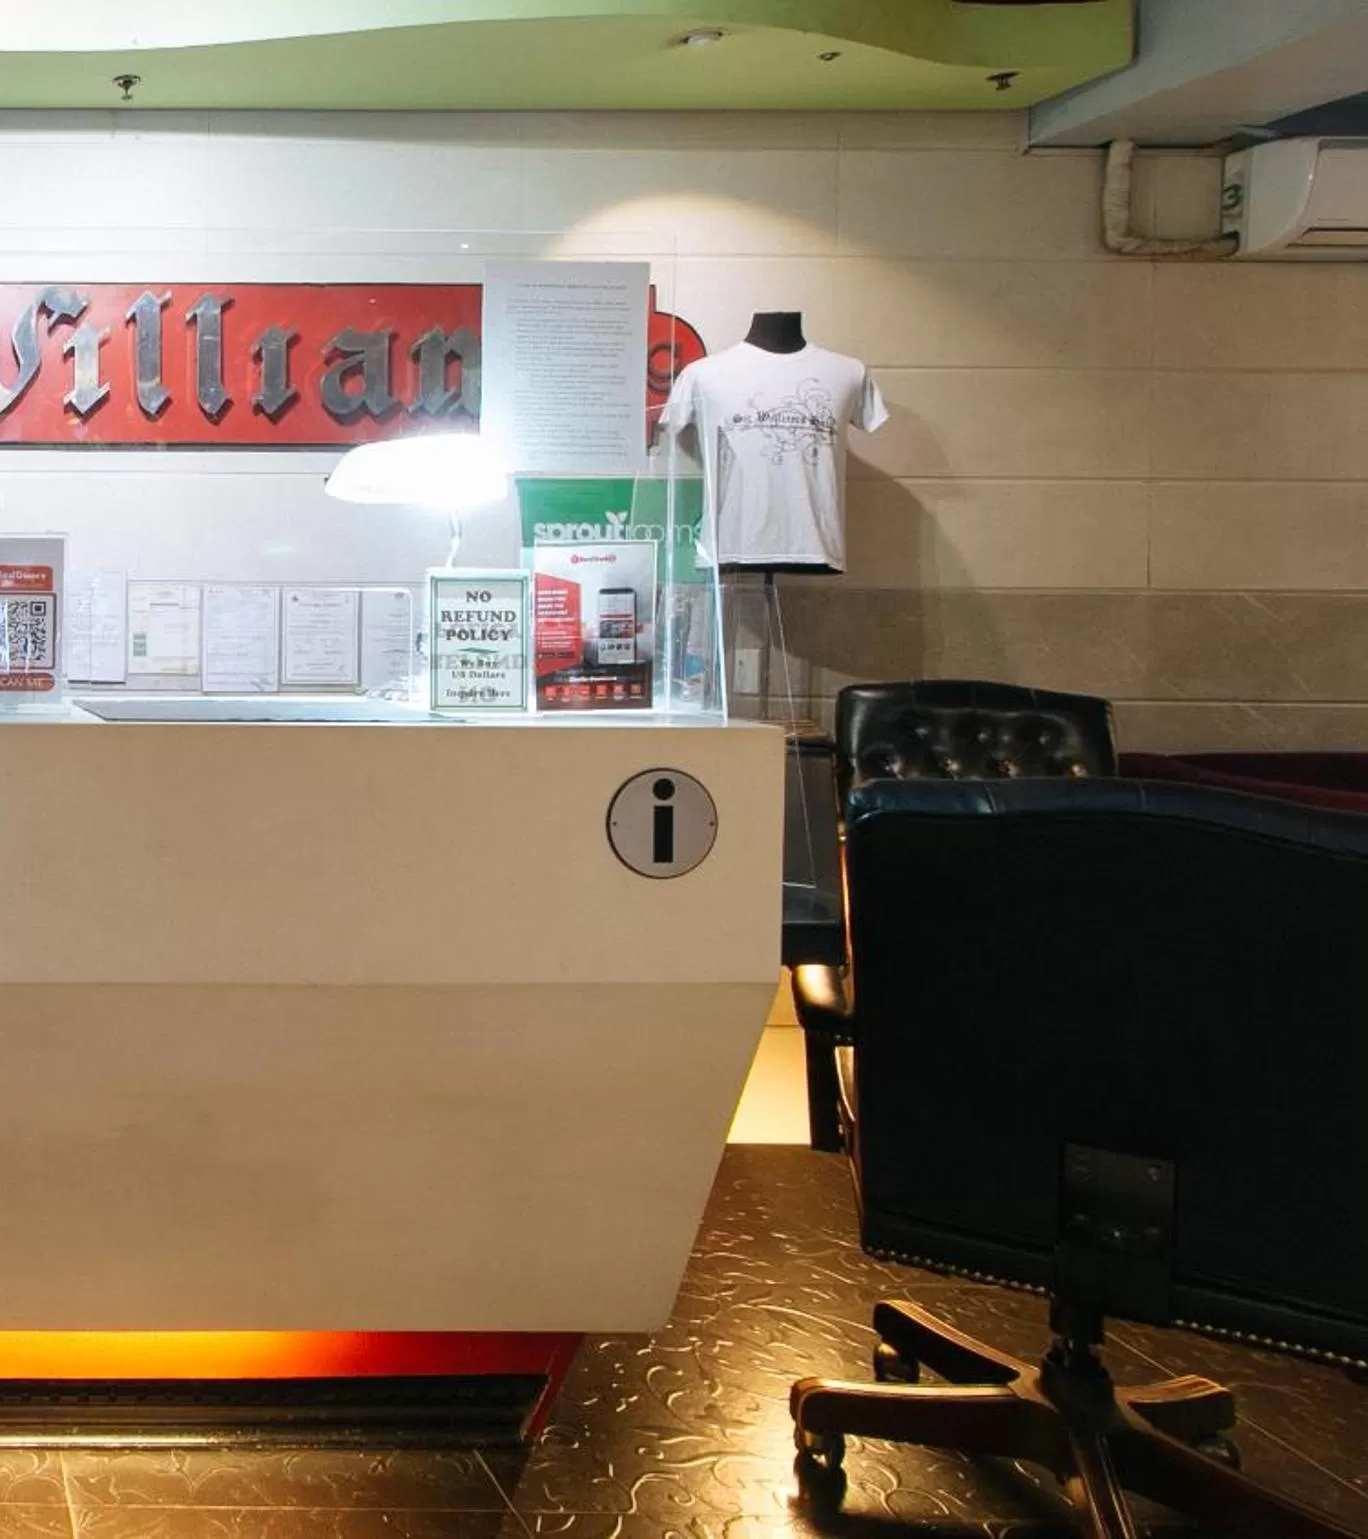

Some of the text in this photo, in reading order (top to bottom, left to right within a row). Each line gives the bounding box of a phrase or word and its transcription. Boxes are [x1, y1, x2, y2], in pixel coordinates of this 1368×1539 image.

[466, 590, 492, 602] NO
[440, 610, 517, 622] REFUND
[445, 628, 512, 641] POLICY
[26, 676, 44, 687] ME
